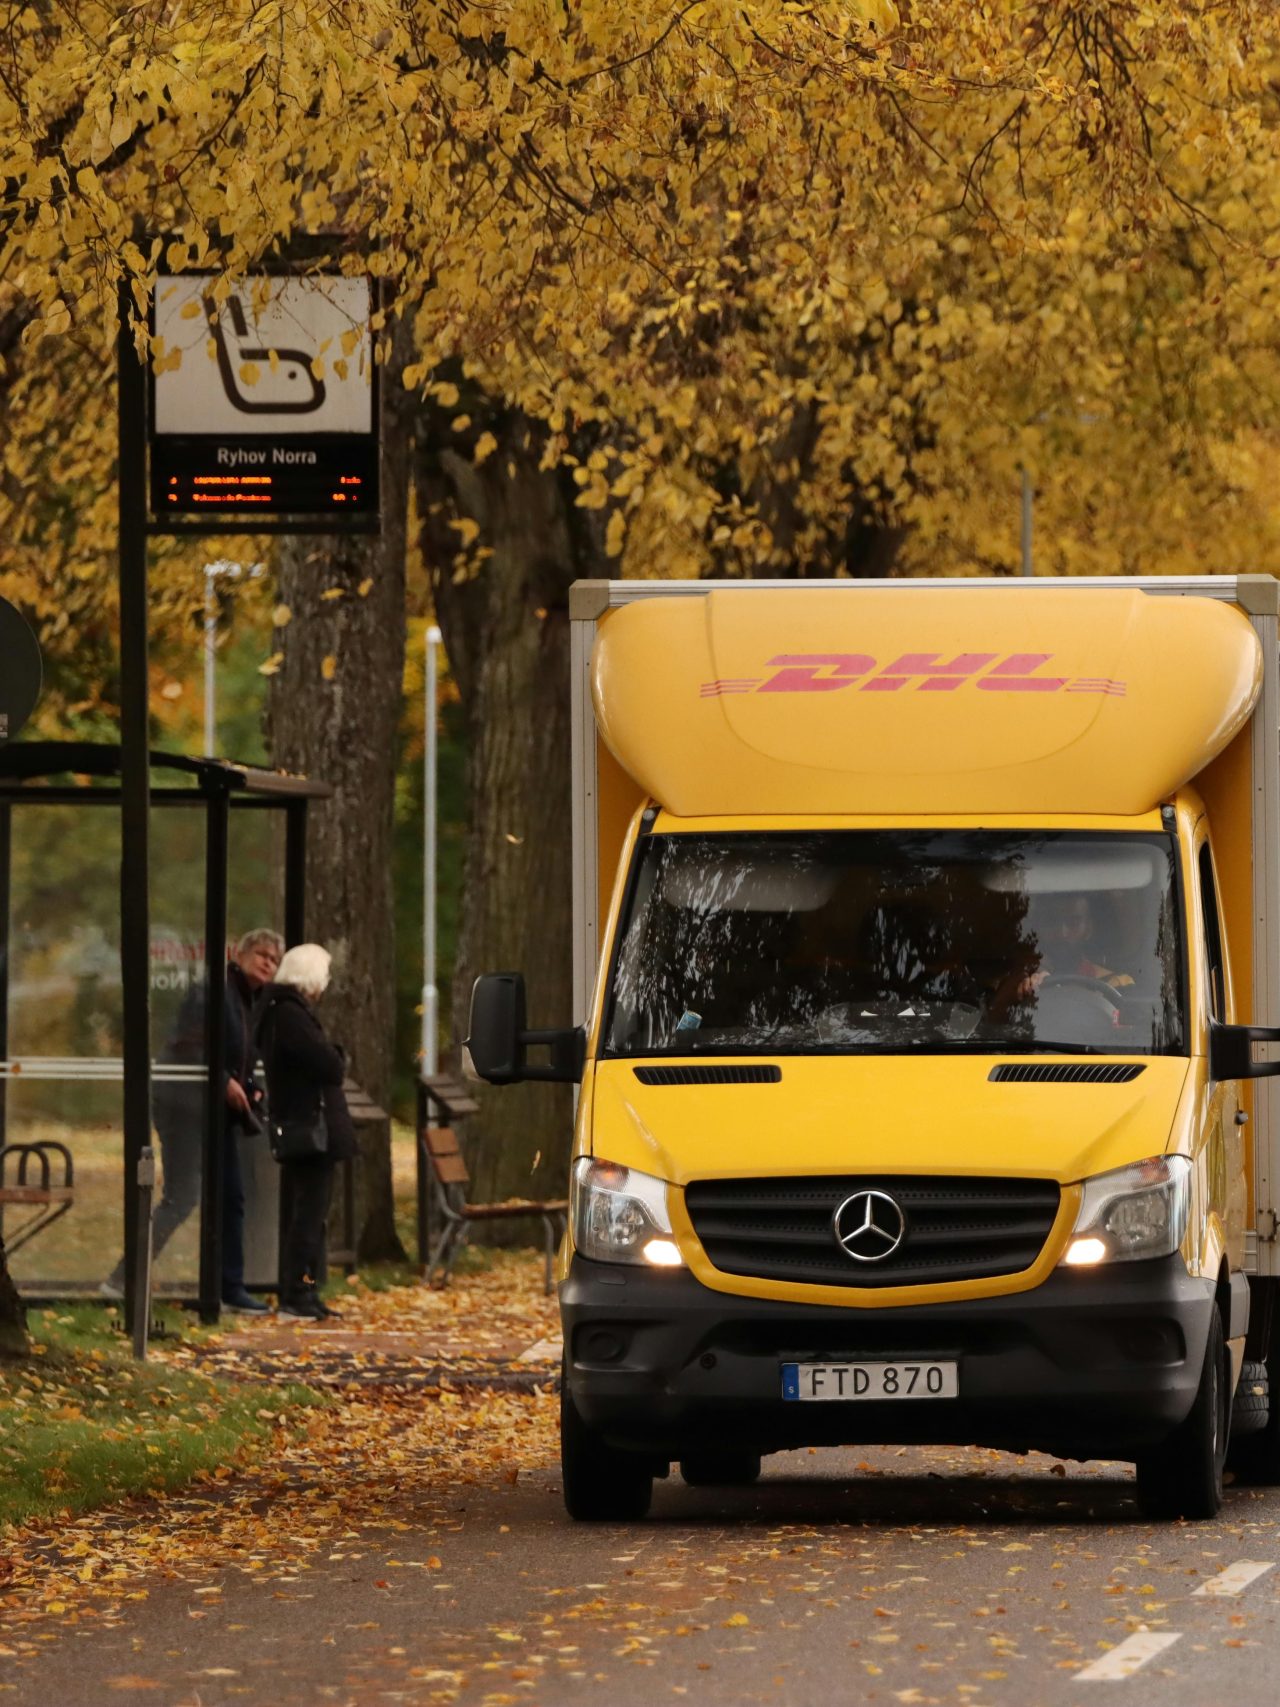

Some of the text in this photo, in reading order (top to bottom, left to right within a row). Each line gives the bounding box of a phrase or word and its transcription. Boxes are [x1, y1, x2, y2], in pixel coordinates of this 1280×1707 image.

[217, 447, 317, 468] Ryhov Norra
[755, 653, 1071, 692] DHL
[788, 1386, 795, 1394] S
[811, 1366, 943, 1396] FTD 870
